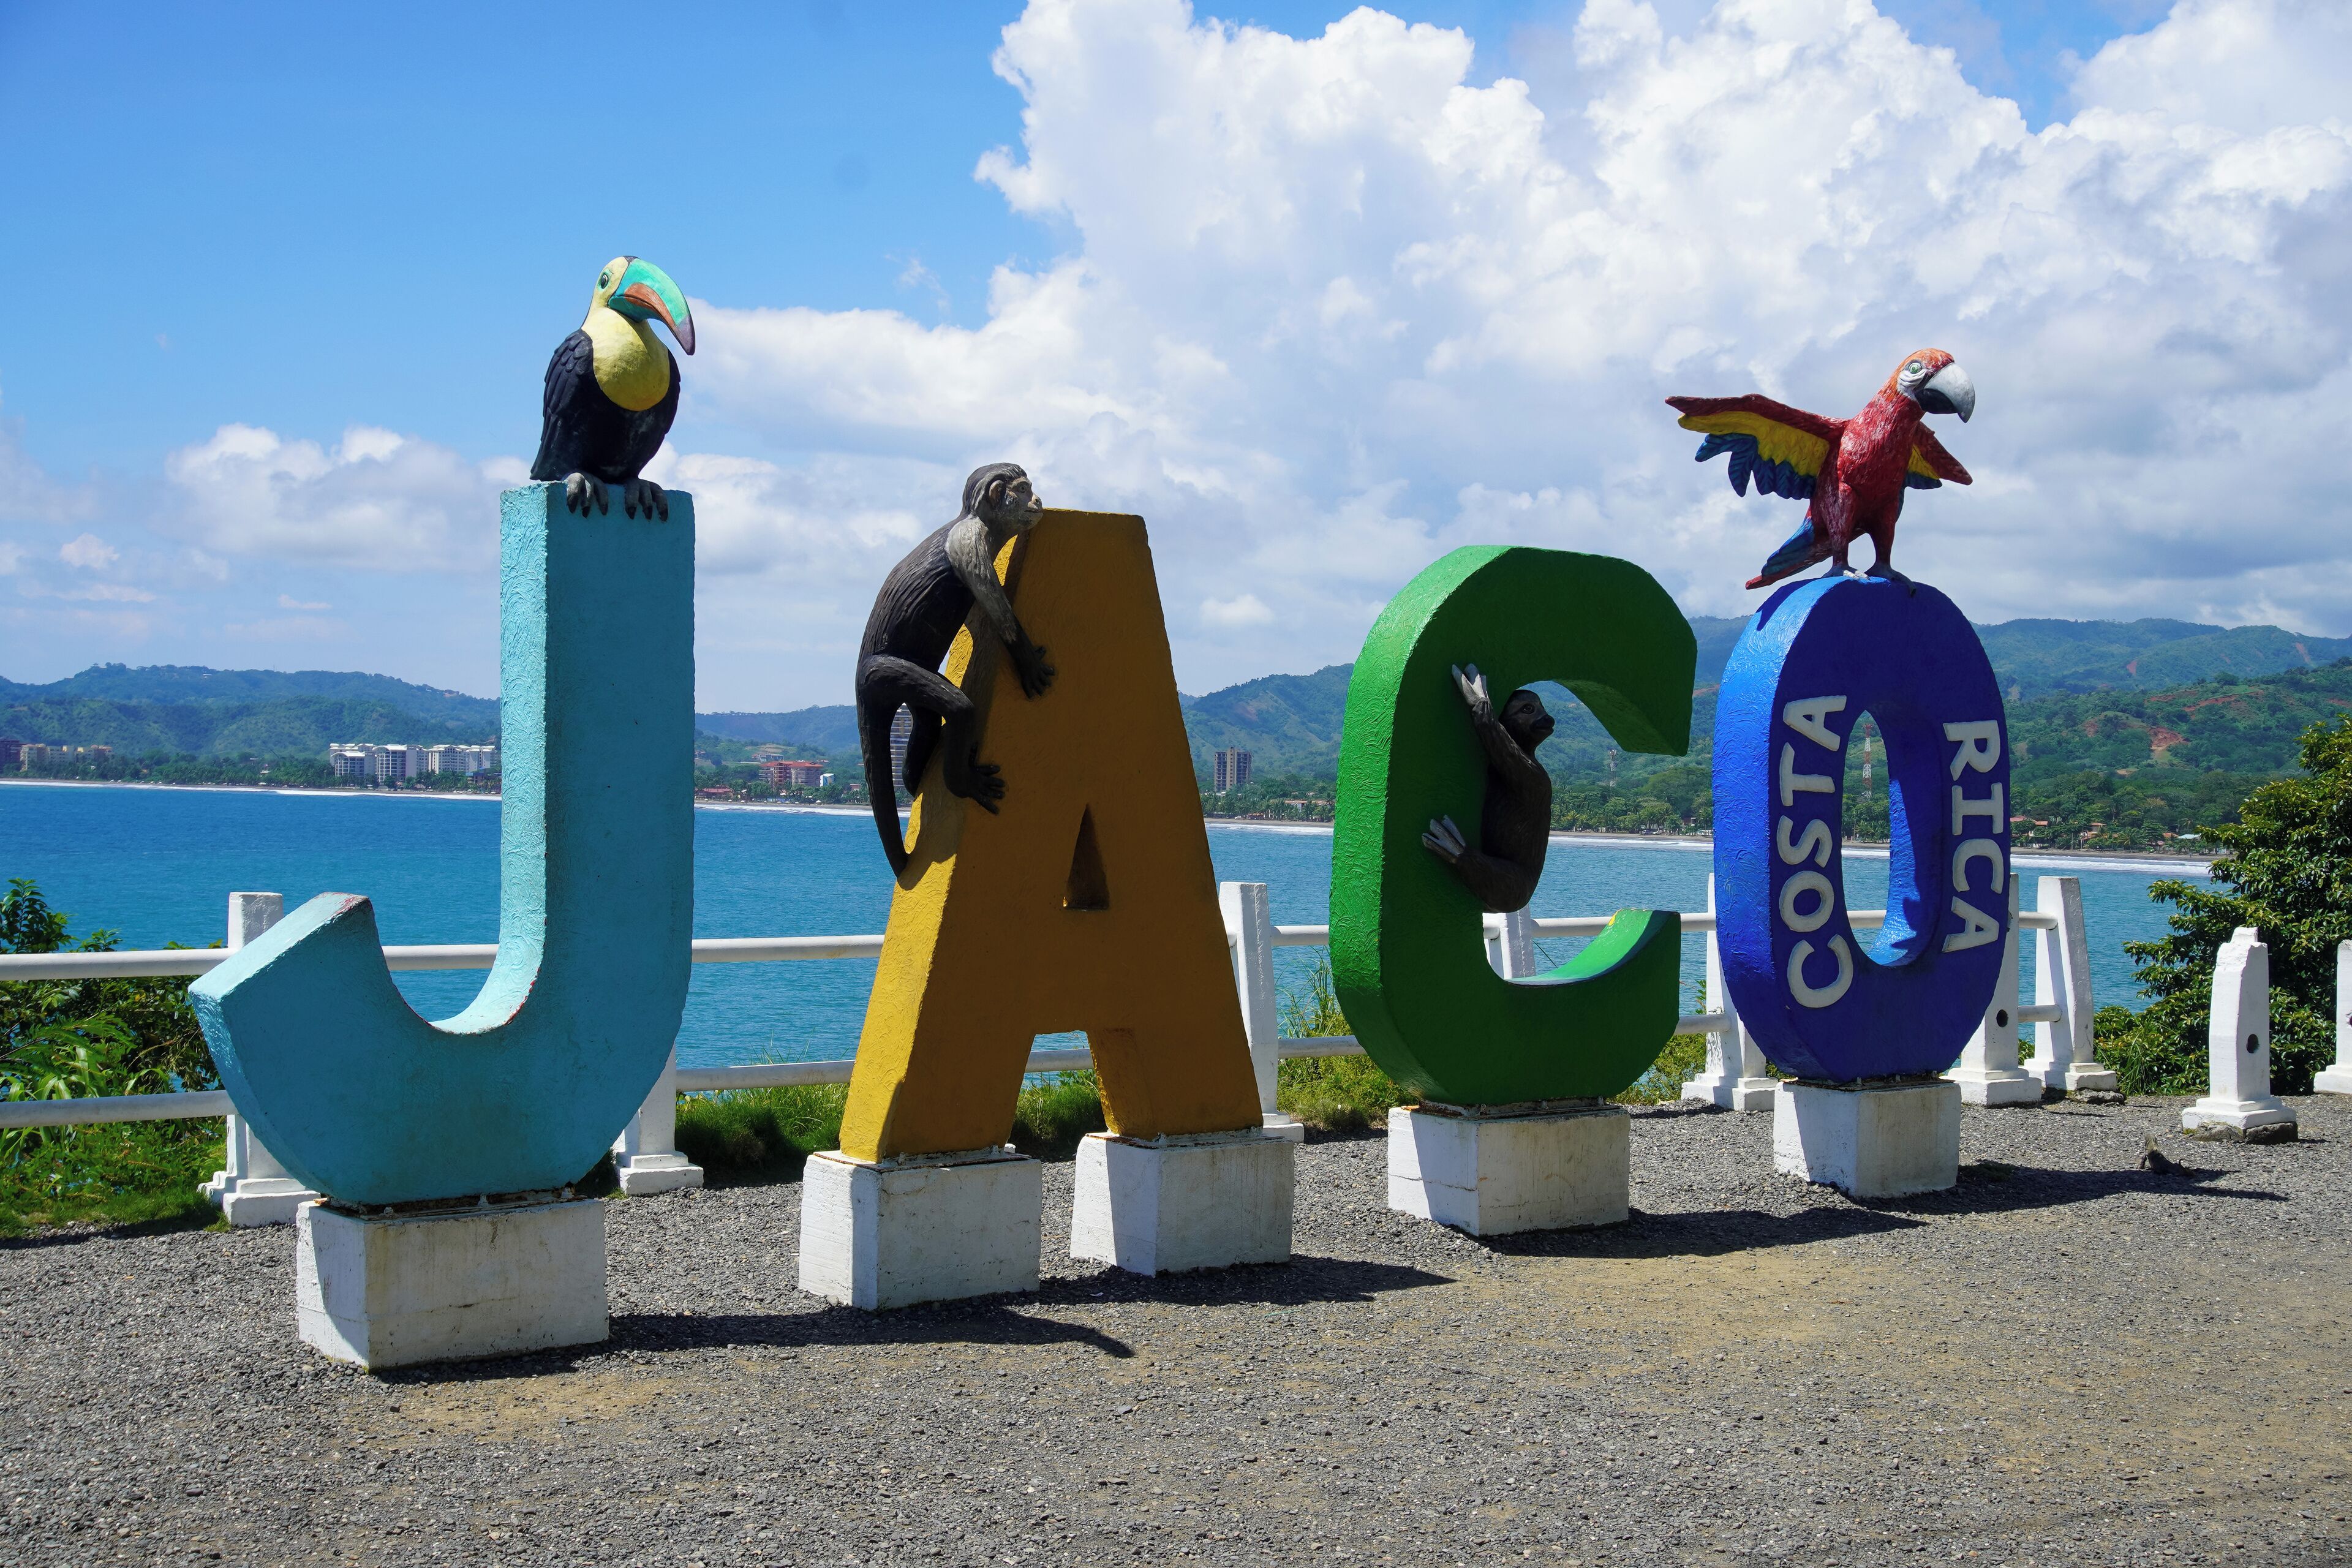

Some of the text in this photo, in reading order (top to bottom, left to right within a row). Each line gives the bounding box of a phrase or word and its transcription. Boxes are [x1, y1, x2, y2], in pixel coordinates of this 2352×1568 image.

[189, 479, 2011, 1204] JACO
[1777, 695, 1853, 1008] COSTA
[1943, 720, 2003, 952] RICA
